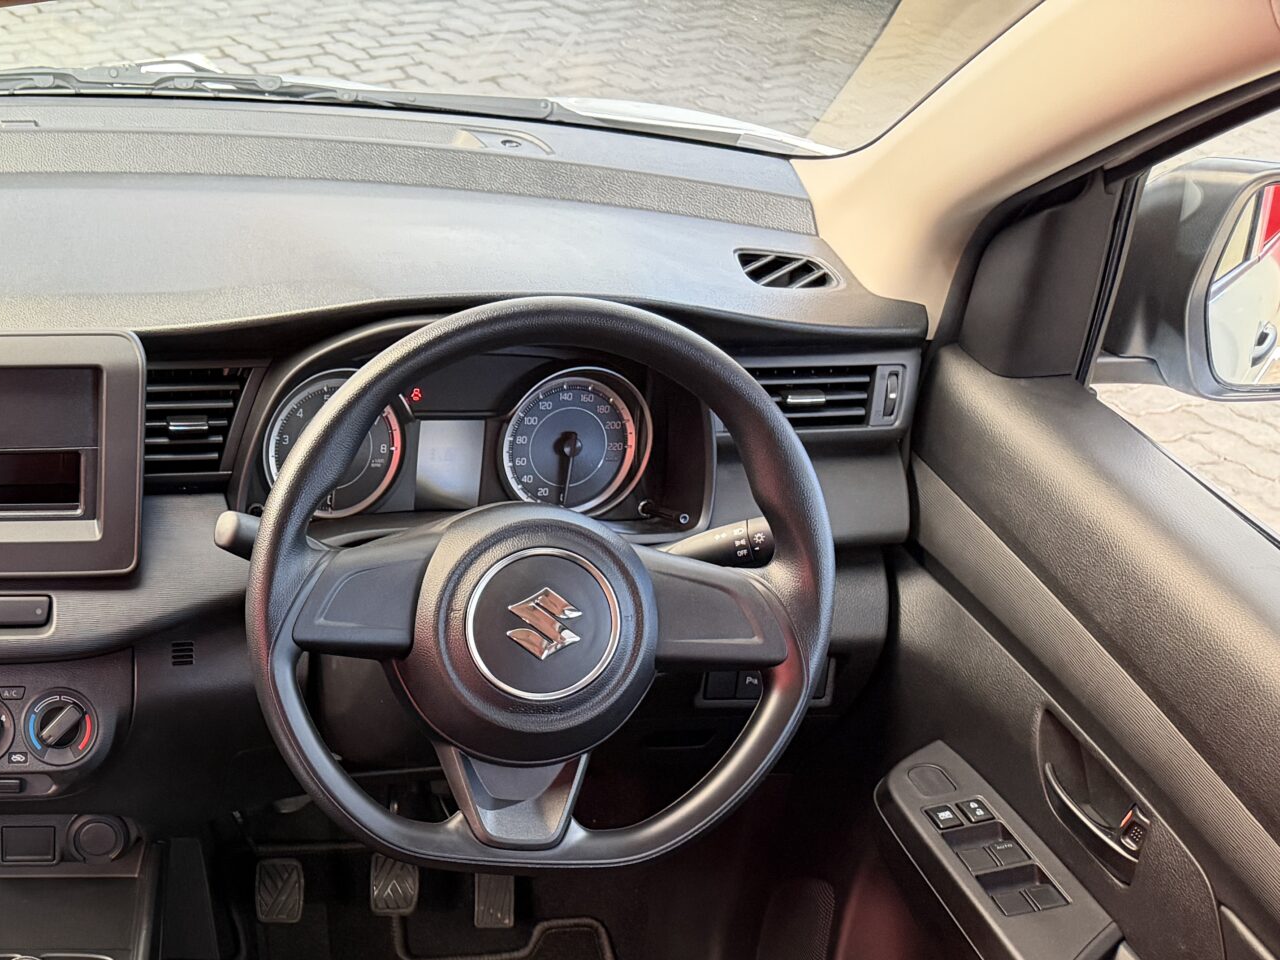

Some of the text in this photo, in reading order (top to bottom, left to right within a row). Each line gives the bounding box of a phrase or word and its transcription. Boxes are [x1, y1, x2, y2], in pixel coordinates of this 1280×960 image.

[560, 392, 573, 400] 140
[581, 394, 594, 402] 160
[539, 402, 552, 410] 120
[597, 405, 610, 413] 180
[296, 408, 303, 418] 4
[524, 416, 538, 425] 100
[605, 421, 621, 429] 200
[282, 435, 289, 445] 3
[516, 436, 528, 444] 80
[380, 444, 387, 453] 8
[607, 442, 623, 451] 220
[515, 458, 527, 466] 60
[521, 475, 533, 483] 40
[537, 488, 549, 496] 20
[736, 549, 748, 557] OFF
[0, 714, 6, 722] 4
